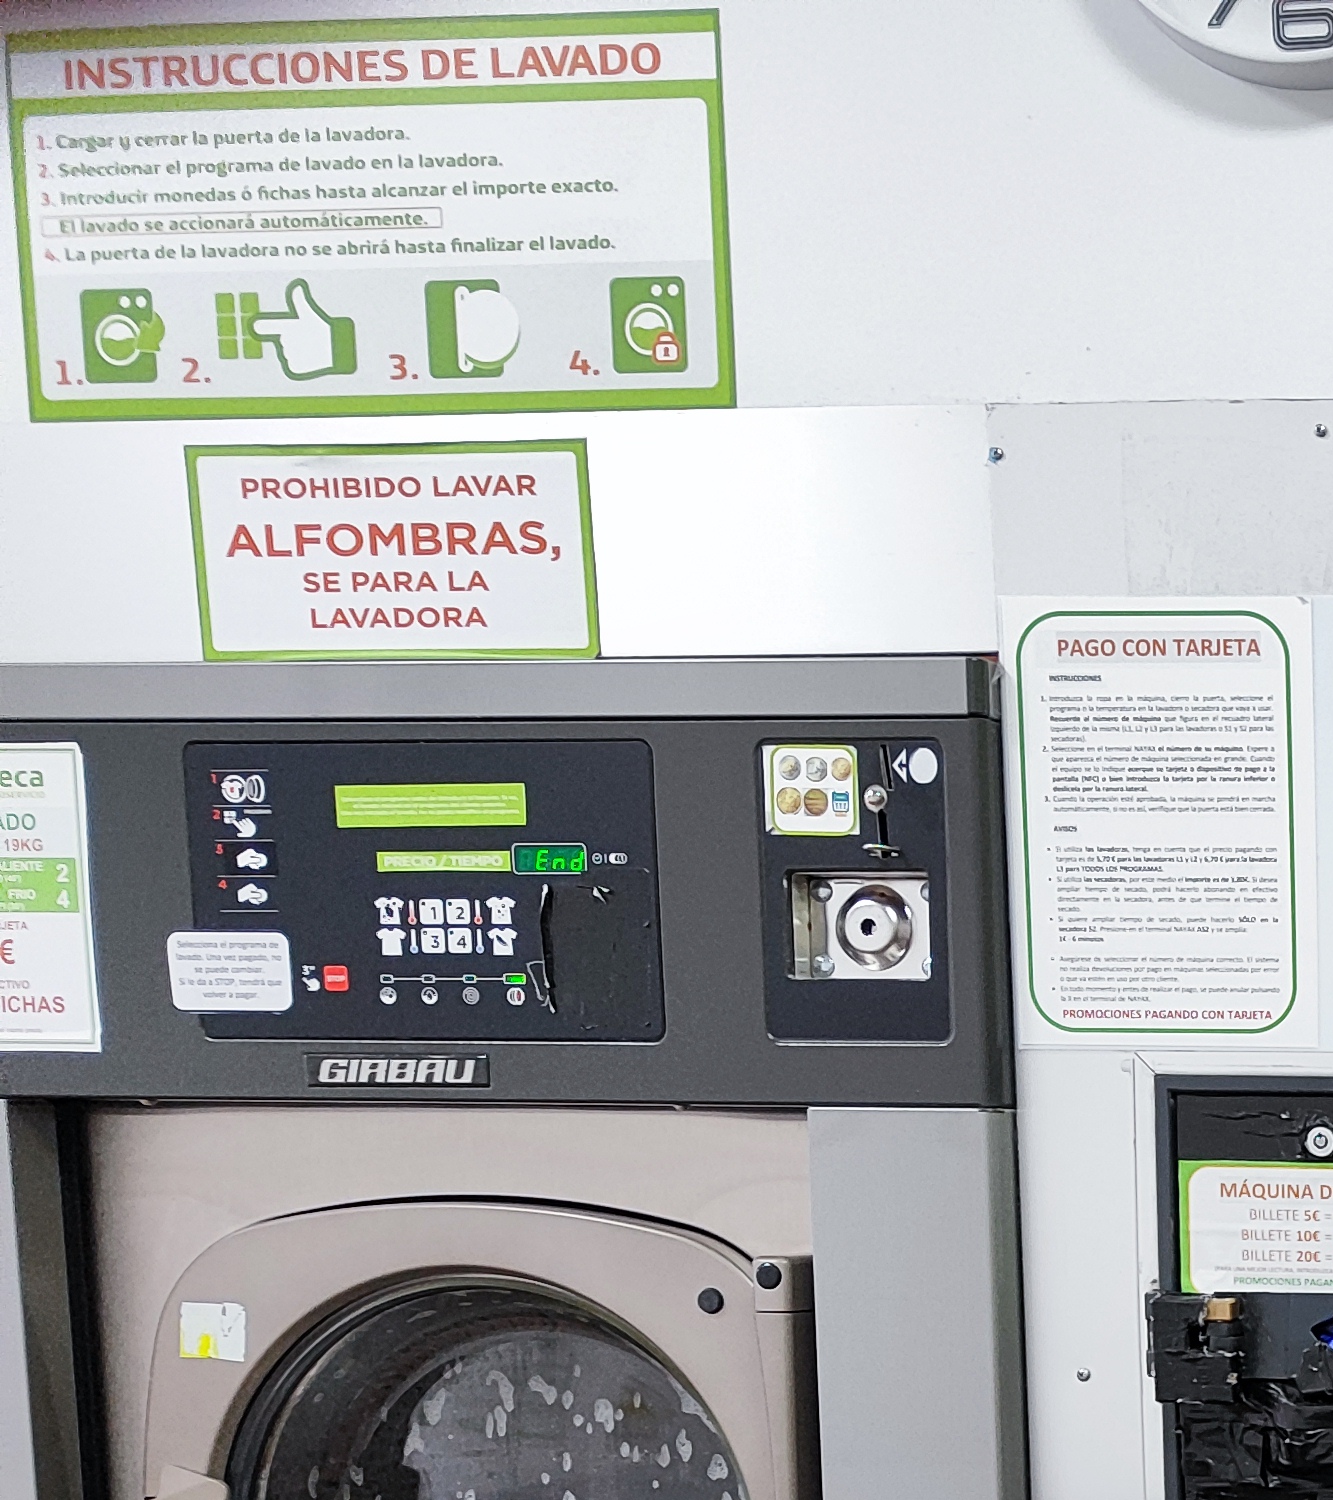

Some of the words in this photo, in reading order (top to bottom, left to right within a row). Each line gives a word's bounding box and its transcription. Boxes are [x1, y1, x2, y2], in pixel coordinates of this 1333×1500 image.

[64, 49, 408, 90] INSTRUCCIONES
[421, 48, 478, 80] DE
[490, 43, 661, 78] LAVADO
[64, 248, 86, 261] La
[91, 248, 149, 265] puerta
[155, 245, 176, 259] de
[181, 244, 196, 258] la
[201, 243, 279, 258] lavadora
[285, 246, 307, 256] no
[312, 245, 332, 255] se
[337, 239, 390, 255] abrirá
[395, 240, 446, 254] hasta
[451, 237, 524, 252] finalizar
[529, 236, 544, 250] el
[550, 235, 615, 250] lavado.
[241, 477, 421, 499] PROHIBIDO
[433, 475, 536, 497] LAVAR
[227, 521, 560, 561] ALFOMBRAS,
[304, 572, 341, 592] SE
[352, 571, 438, 592] PARA
[448, 571, 489, 591] LA
[311, 607, 487, 628] LAVADORA
[1058, 639, 1115, 656] PAGO
[1123, 639, 1166, 656] CON
[1173, 639, 1260, 656] TARJETA
[4, 839, 43, 851] 19KG
[535, 848, 585, 871] End
[1063, 1010, 1141, 1019] PROMOCIONES
[1145, 1010, 1198, 1019] PAGANDO
[1202, 1010, 1224, 1019] CON
[1228, 1011, 1272, 1019] TARJETA
[1221, 1179, 1313, 1200] MÁQUINA
[1250, 1209, 1299, 1221] BILLETE
[1305, 1210, 1320, 1221] 5€
